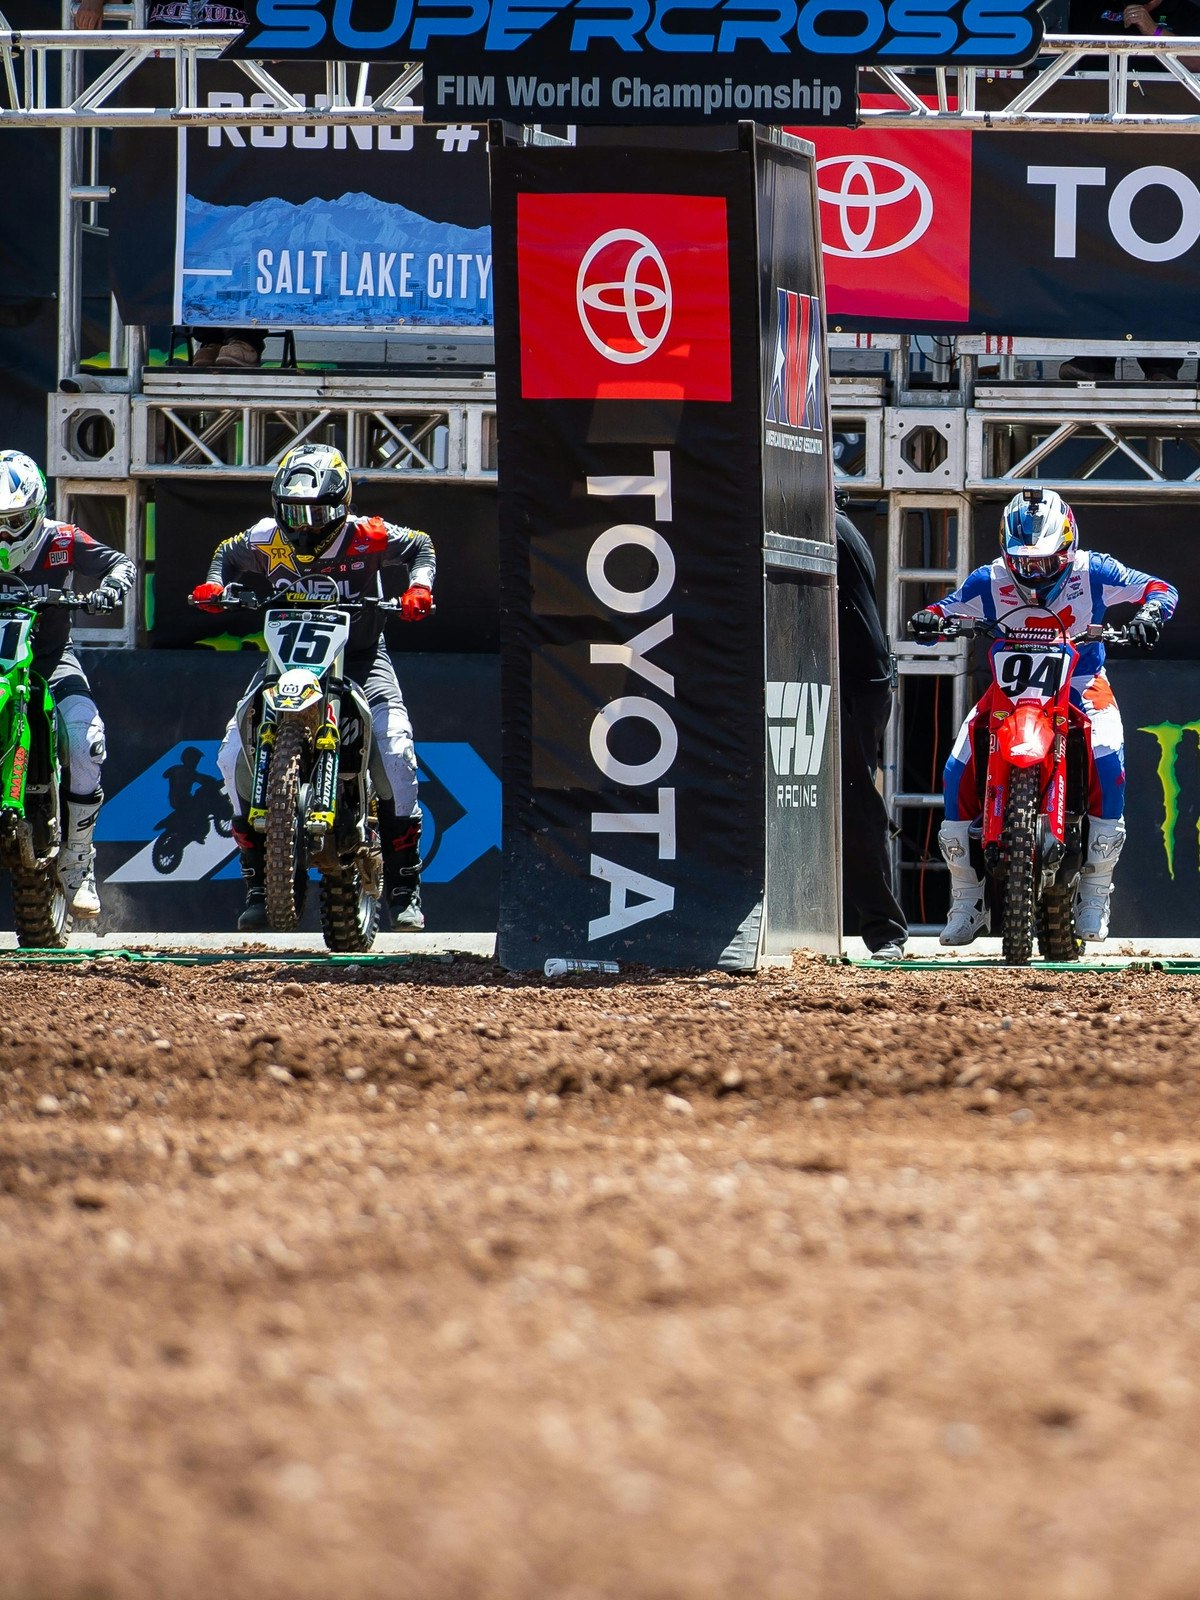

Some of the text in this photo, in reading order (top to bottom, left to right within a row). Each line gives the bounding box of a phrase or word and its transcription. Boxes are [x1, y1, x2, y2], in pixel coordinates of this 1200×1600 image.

[246, 0, 1035, 57] SUPERCROSS
[437, 75, 841, 115] FIM World Championship
[257, 248, 492, 300] SALT LAKE CITY
[277, 622, 336, 664] 15
[587, 450, 678, 941] TOYOTA
[1001, 654, 1062, 697] 94
[322, 752, 335, 807] DUNLOP
[777, 784, 817, 808] RACING
[1056, 775, 1064, 826] DUNLOP
